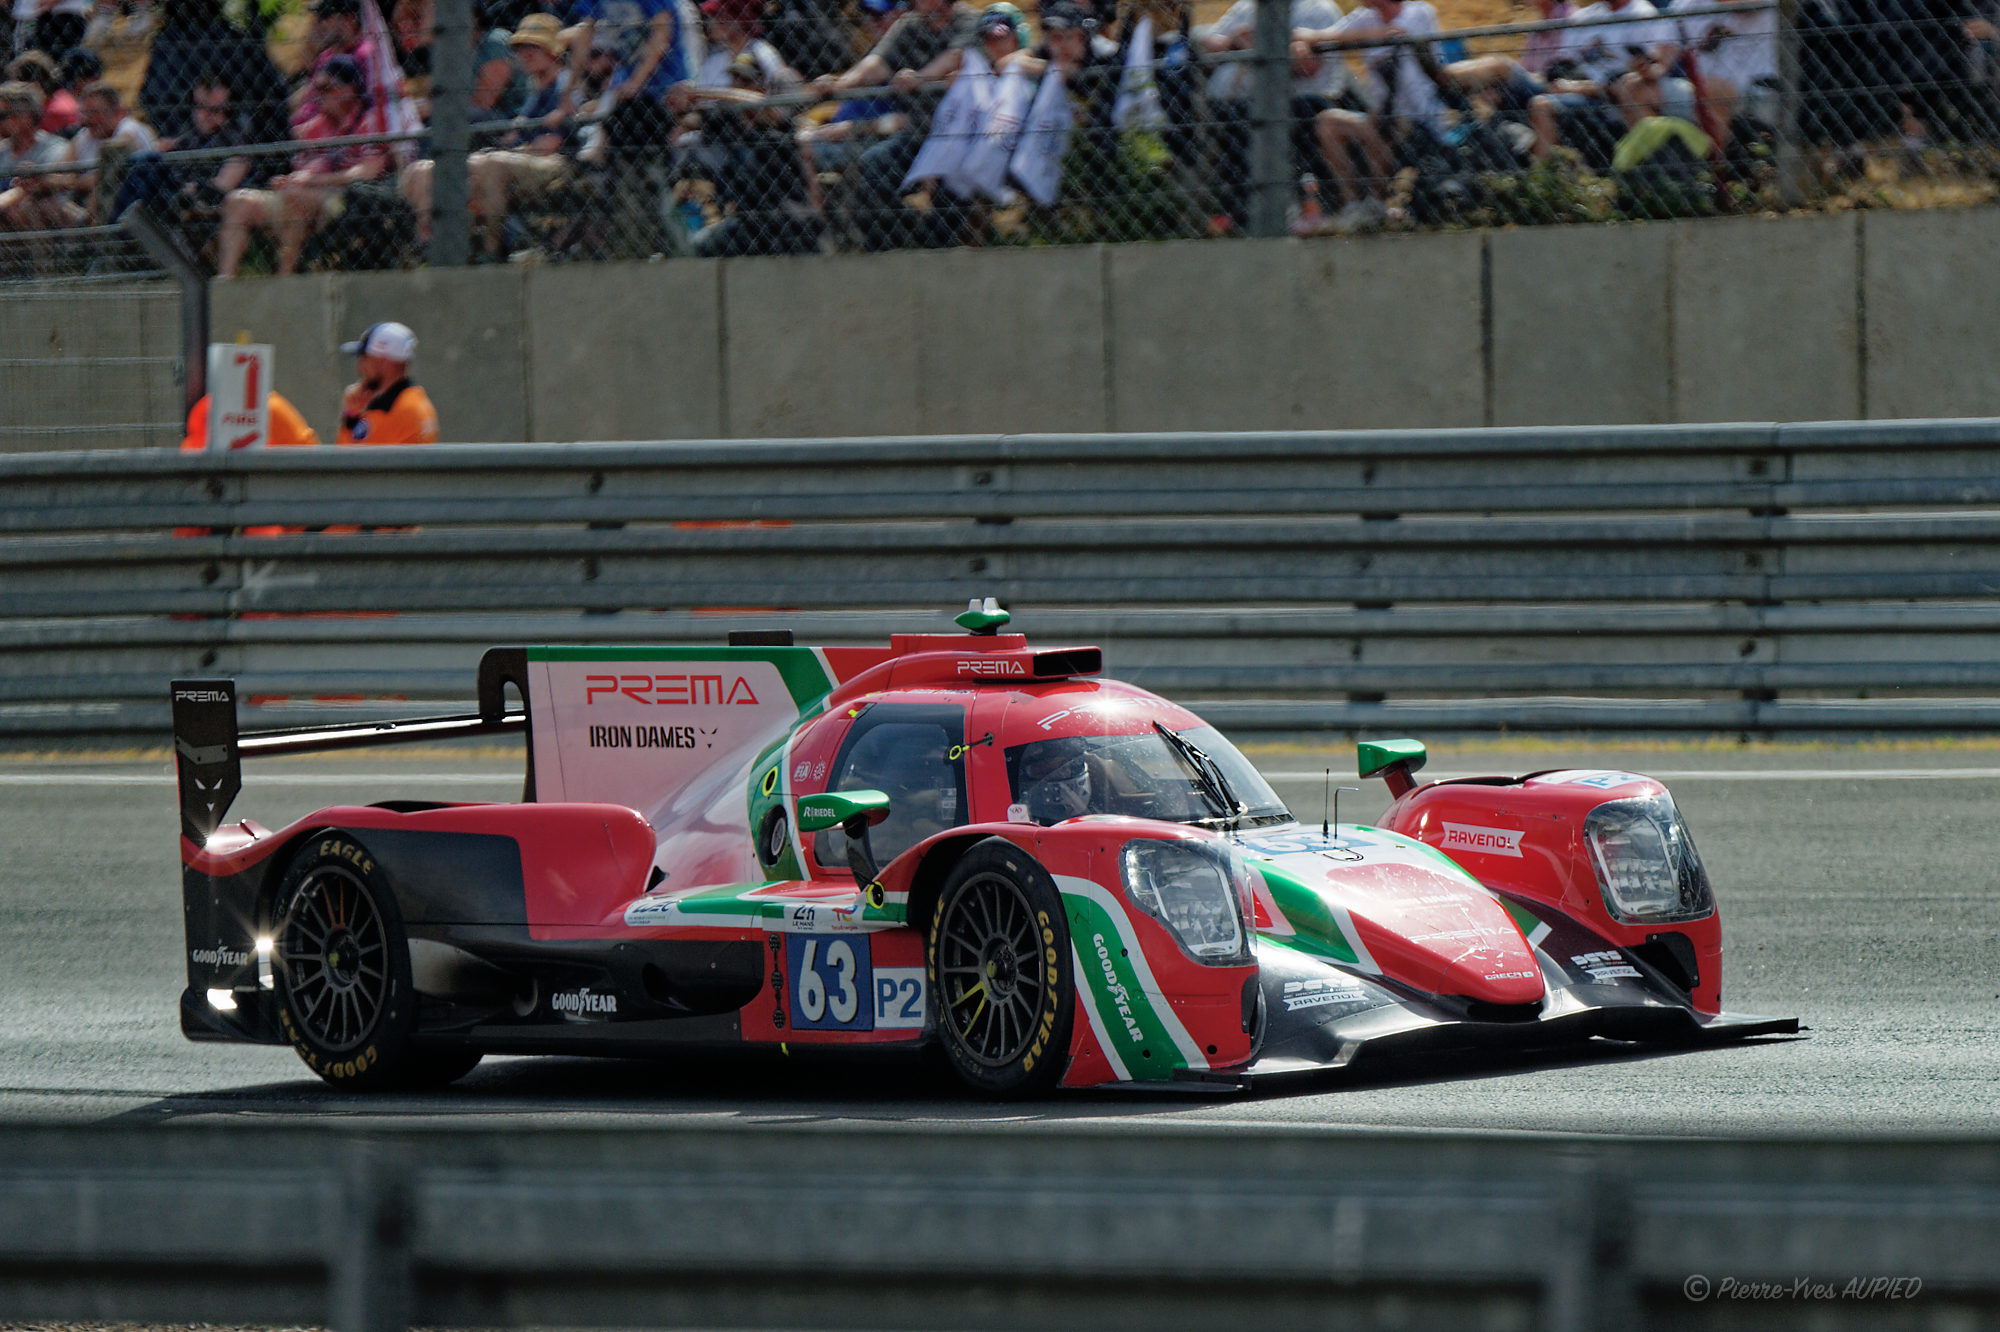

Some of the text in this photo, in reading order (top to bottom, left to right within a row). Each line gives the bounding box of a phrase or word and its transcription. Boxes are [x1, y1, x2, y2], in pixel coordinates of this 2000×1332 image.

[957, 661, 1025, 674] PREMA
[175, 690, 230, 702] PREMA
[586, 675, 760, 705] PREMA
[589, 725, 696, 749] IRON DAMES
[814, 807, 836, 818] RIEDEL
[1448, 830, 1515, 850] RAVENOL
[320, 839, 376, 876] EAGLE
[929, 893, 946, 982] EAGLE
[192, 946, 248, 968] GOODYEAR
[798, 940, 858, 1024] 63
[1023, 910, 1058, 1073] GOODYEAR
[1093, 933, 1144, 1043] GOODYEAR
[551, 988, 617, 1016] GOODYEAR
[876, 978, 922, 1018] P2
[1293, 992, 1360, 1007] RAVENOL
